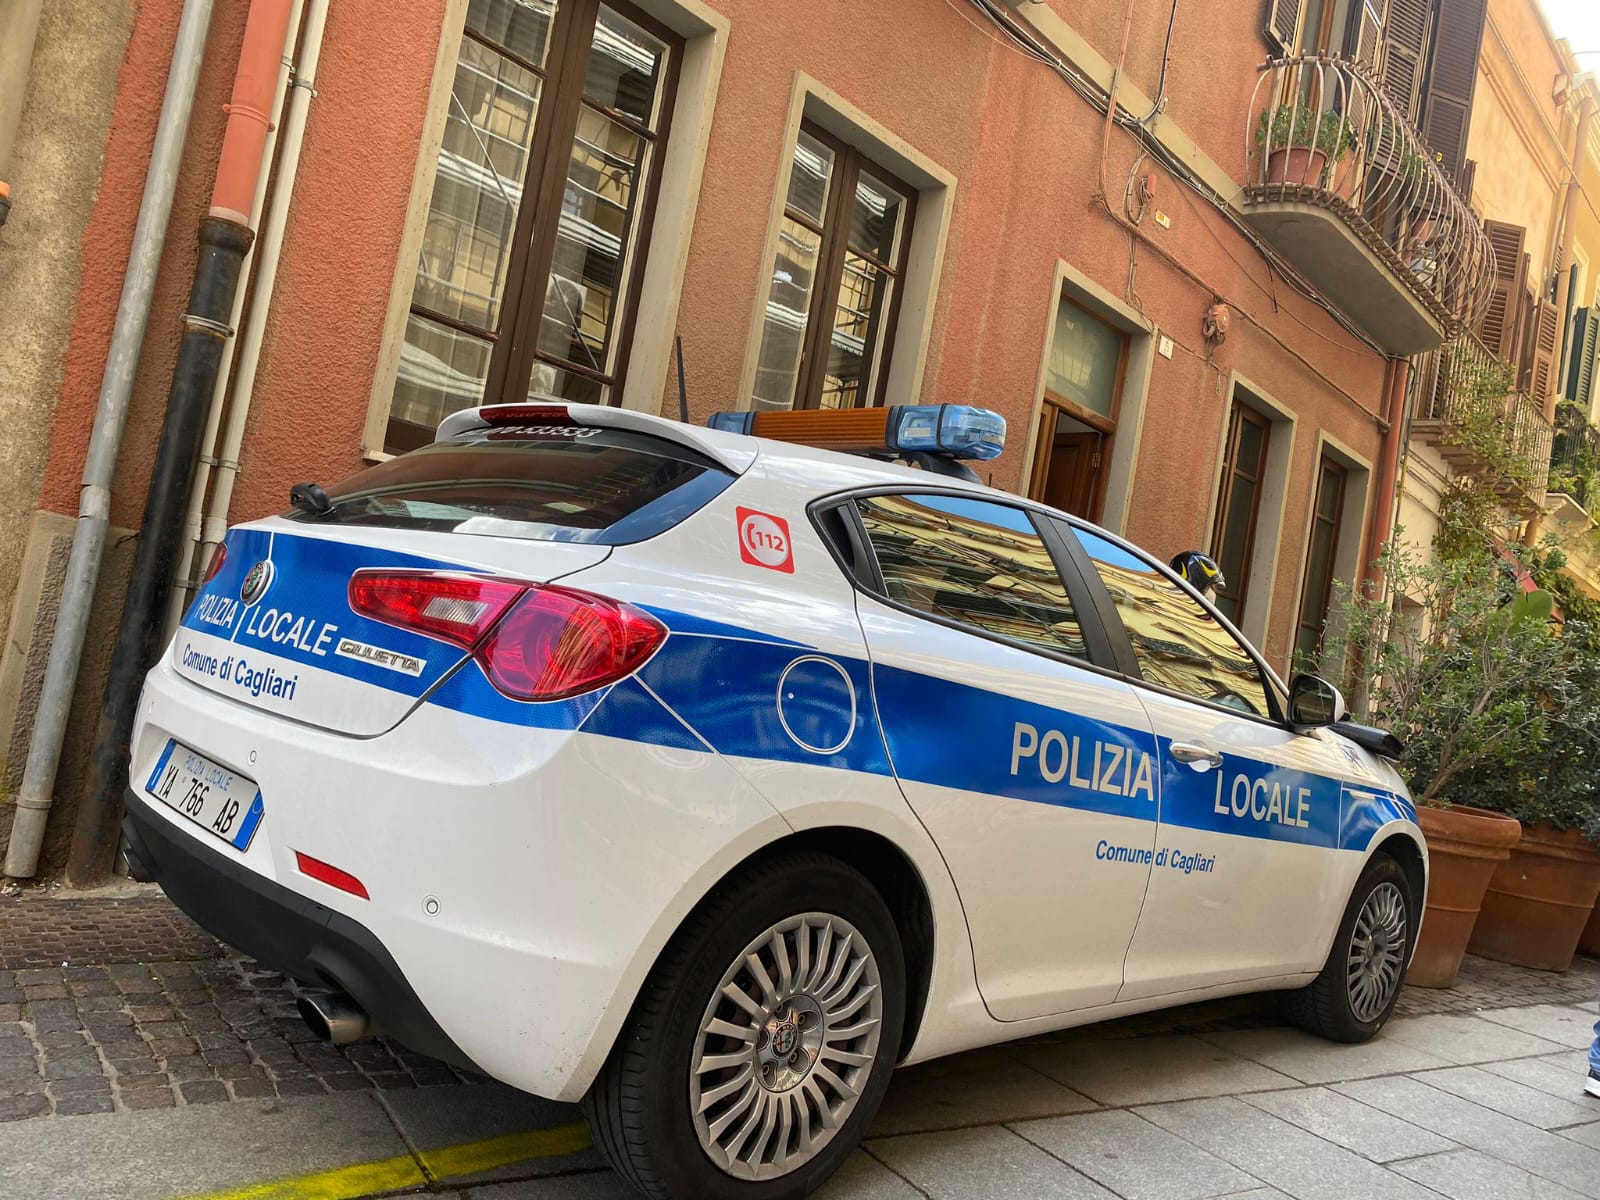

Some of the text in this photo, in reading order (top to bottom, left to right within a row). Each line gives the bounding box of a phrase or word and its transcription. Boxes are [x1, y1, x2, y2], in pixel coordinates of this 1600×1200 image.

[756, 531, 784, 552] 112
[194, 593, 338, 656] POLIZIA LOCALE
[183, 643, 298, 701] Comune di Cagliari
[340, 640, 420, 673] GIULIETTA
[158, 765, 240, 834] YA 766 AB
[1010, 721, 1311, 828] POLIZIA LOCALE
[1095, 840, 1216, 874] Comune di Cagliari
